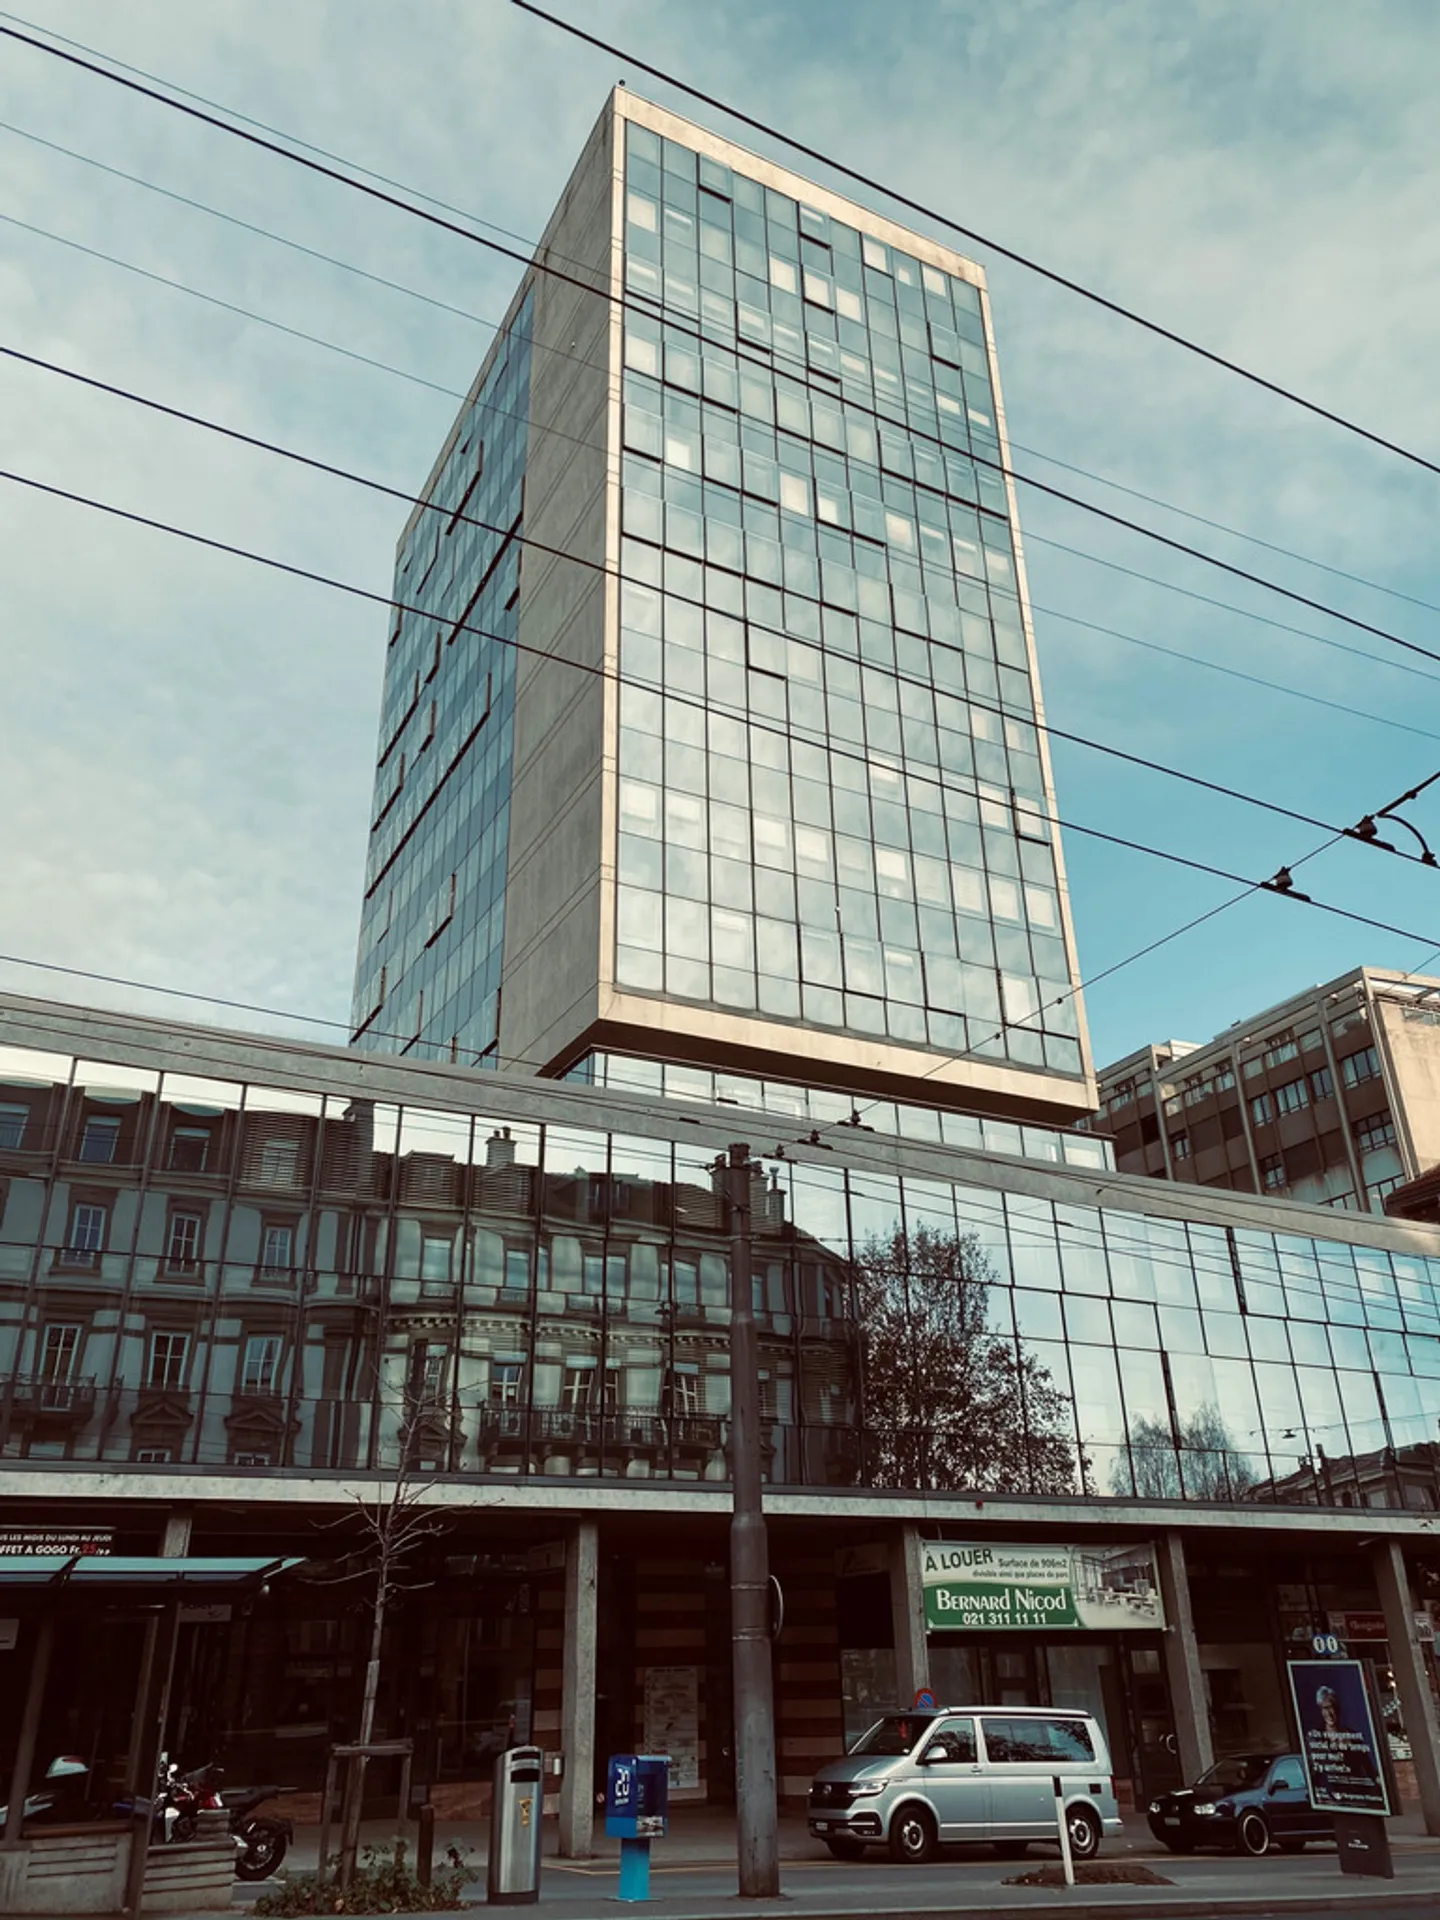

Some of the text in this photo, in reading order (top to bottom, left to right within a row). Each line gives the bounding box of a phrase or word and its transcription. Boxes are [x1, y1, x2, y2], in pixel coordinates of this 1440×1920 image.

[35, 1545, 68, 1554] GOGO
[940, 1548, 993, 1569] LOUER
[998, 1558, 1028, 1568] Surface
[1030, 1559, 1040, 1568] de
[1014, 1588, 1067, 1610] Nicod
[962, 1612, 1047, 1625] 021 311 11 11
